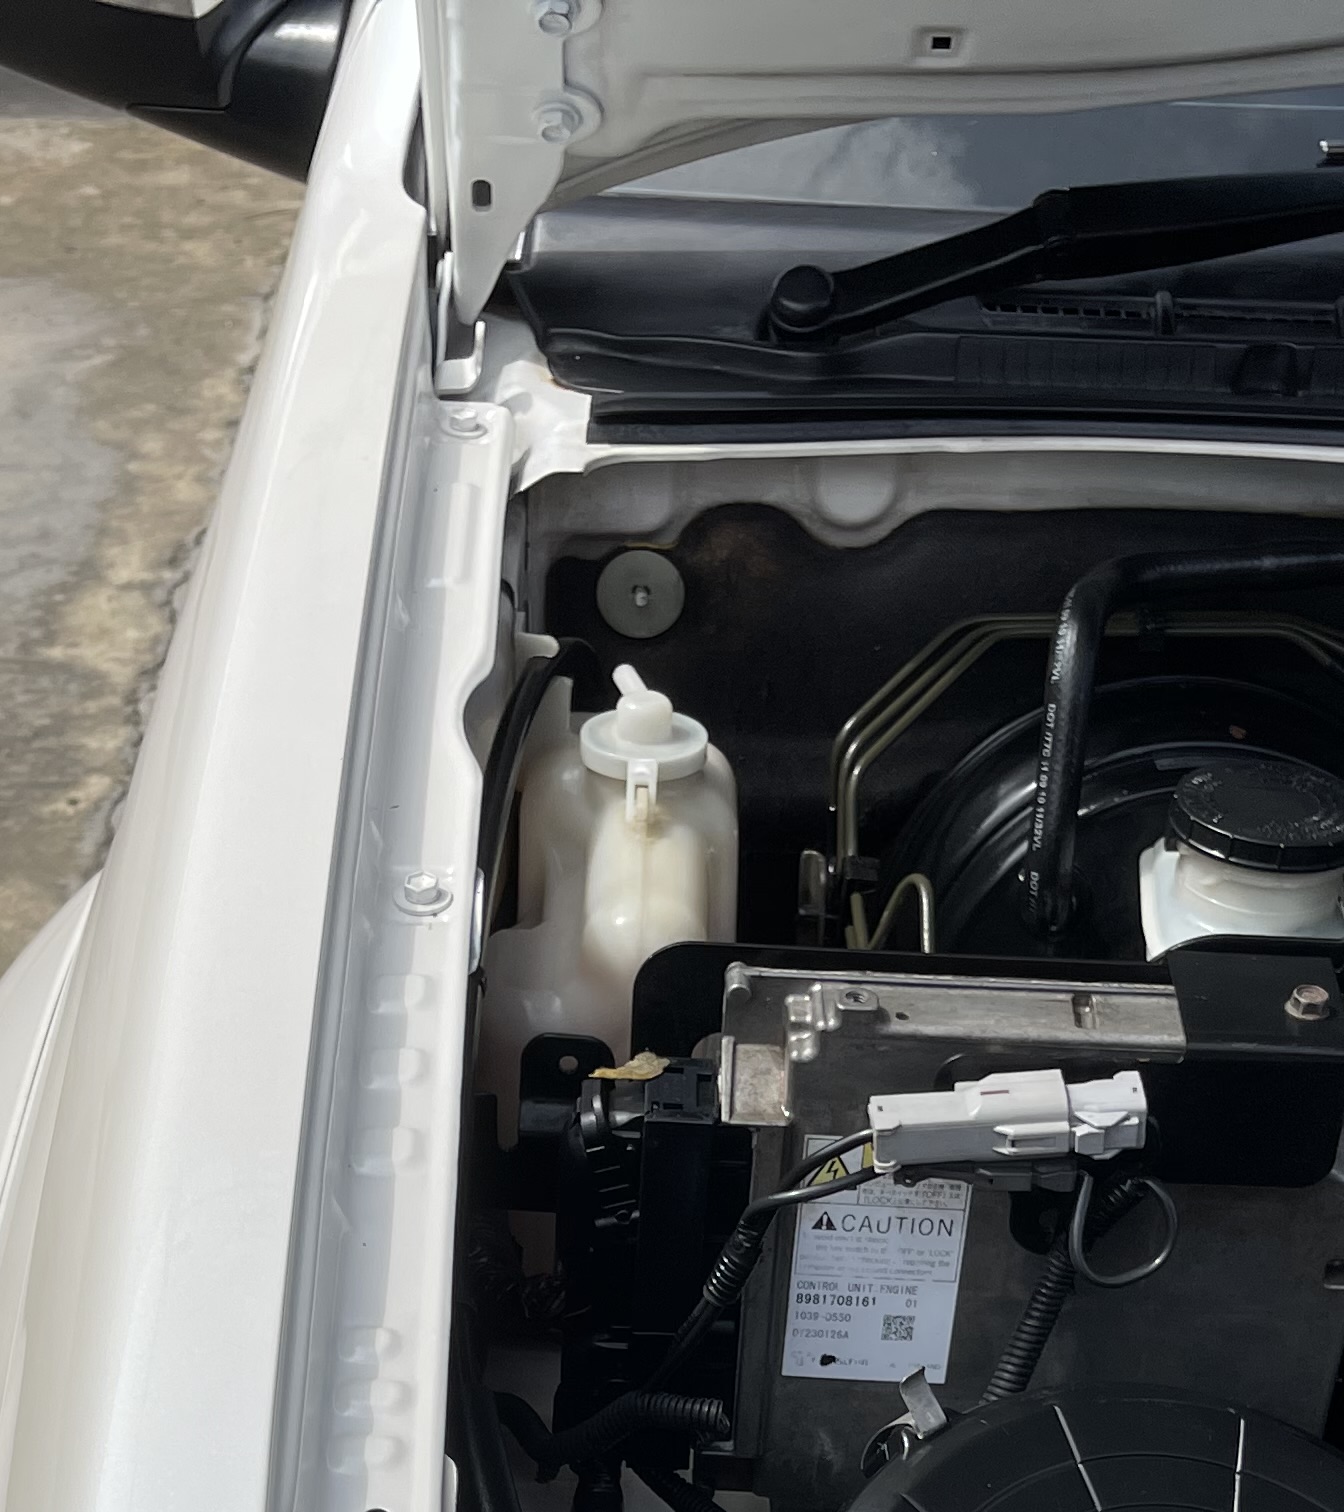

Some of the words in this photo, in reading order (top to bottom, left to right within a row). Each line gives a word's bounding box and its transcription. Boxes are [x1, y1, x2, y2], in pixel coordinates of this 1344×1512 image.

[1045, 703, 1057, 729] DOT
[841, 1213, 955, 1237] CAUTION
[796, 1292, 877, 1308] 8981708161
[904, 1298, 918, 1308] 01
